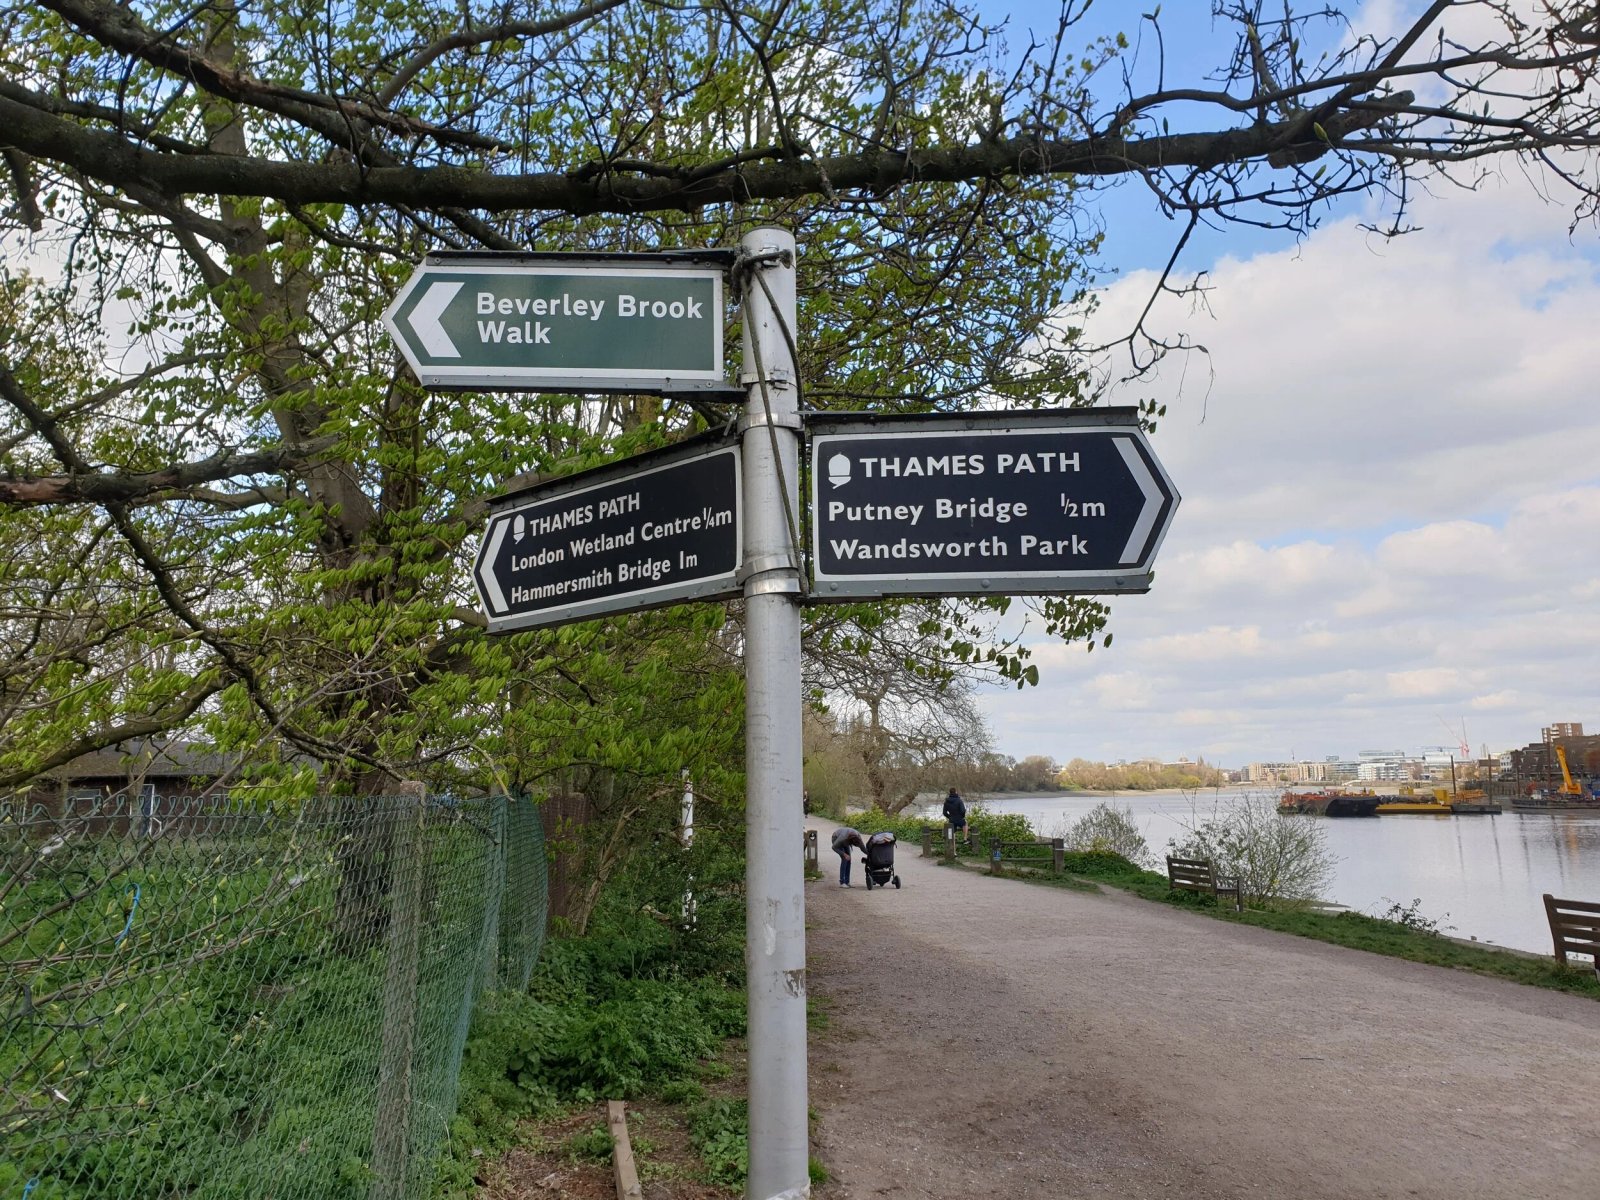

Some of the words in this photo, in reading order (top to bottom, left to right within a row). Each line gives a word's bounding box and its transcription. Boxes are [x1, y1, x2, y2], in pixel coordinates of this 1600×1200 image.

[476, 292, 606, 321] Beverley
[618, 294, 703, 319] Brook
[477, 320, 551, 344] Walk
[859, 454, 985, 478] THAMES
[997, 452, 1080, 474] PATH
[529, 504, 594, 537] THAMES
[599, 492, 640, 520] PATH
[828, 501, 924, 526] Putney
[935, 497, 1028, 524] Bridge
[511, 547, 565, 572] London
[569, 526, 635, 558] Wetland
[641, 516, 702, 542] Centre
[829, 535, 1008, 560] Wandsworth
[1020, 534, 1088, 556] Park
[511, 567, 612, 605] Hammersmith
[618, 557, 671, 583] Bridge
